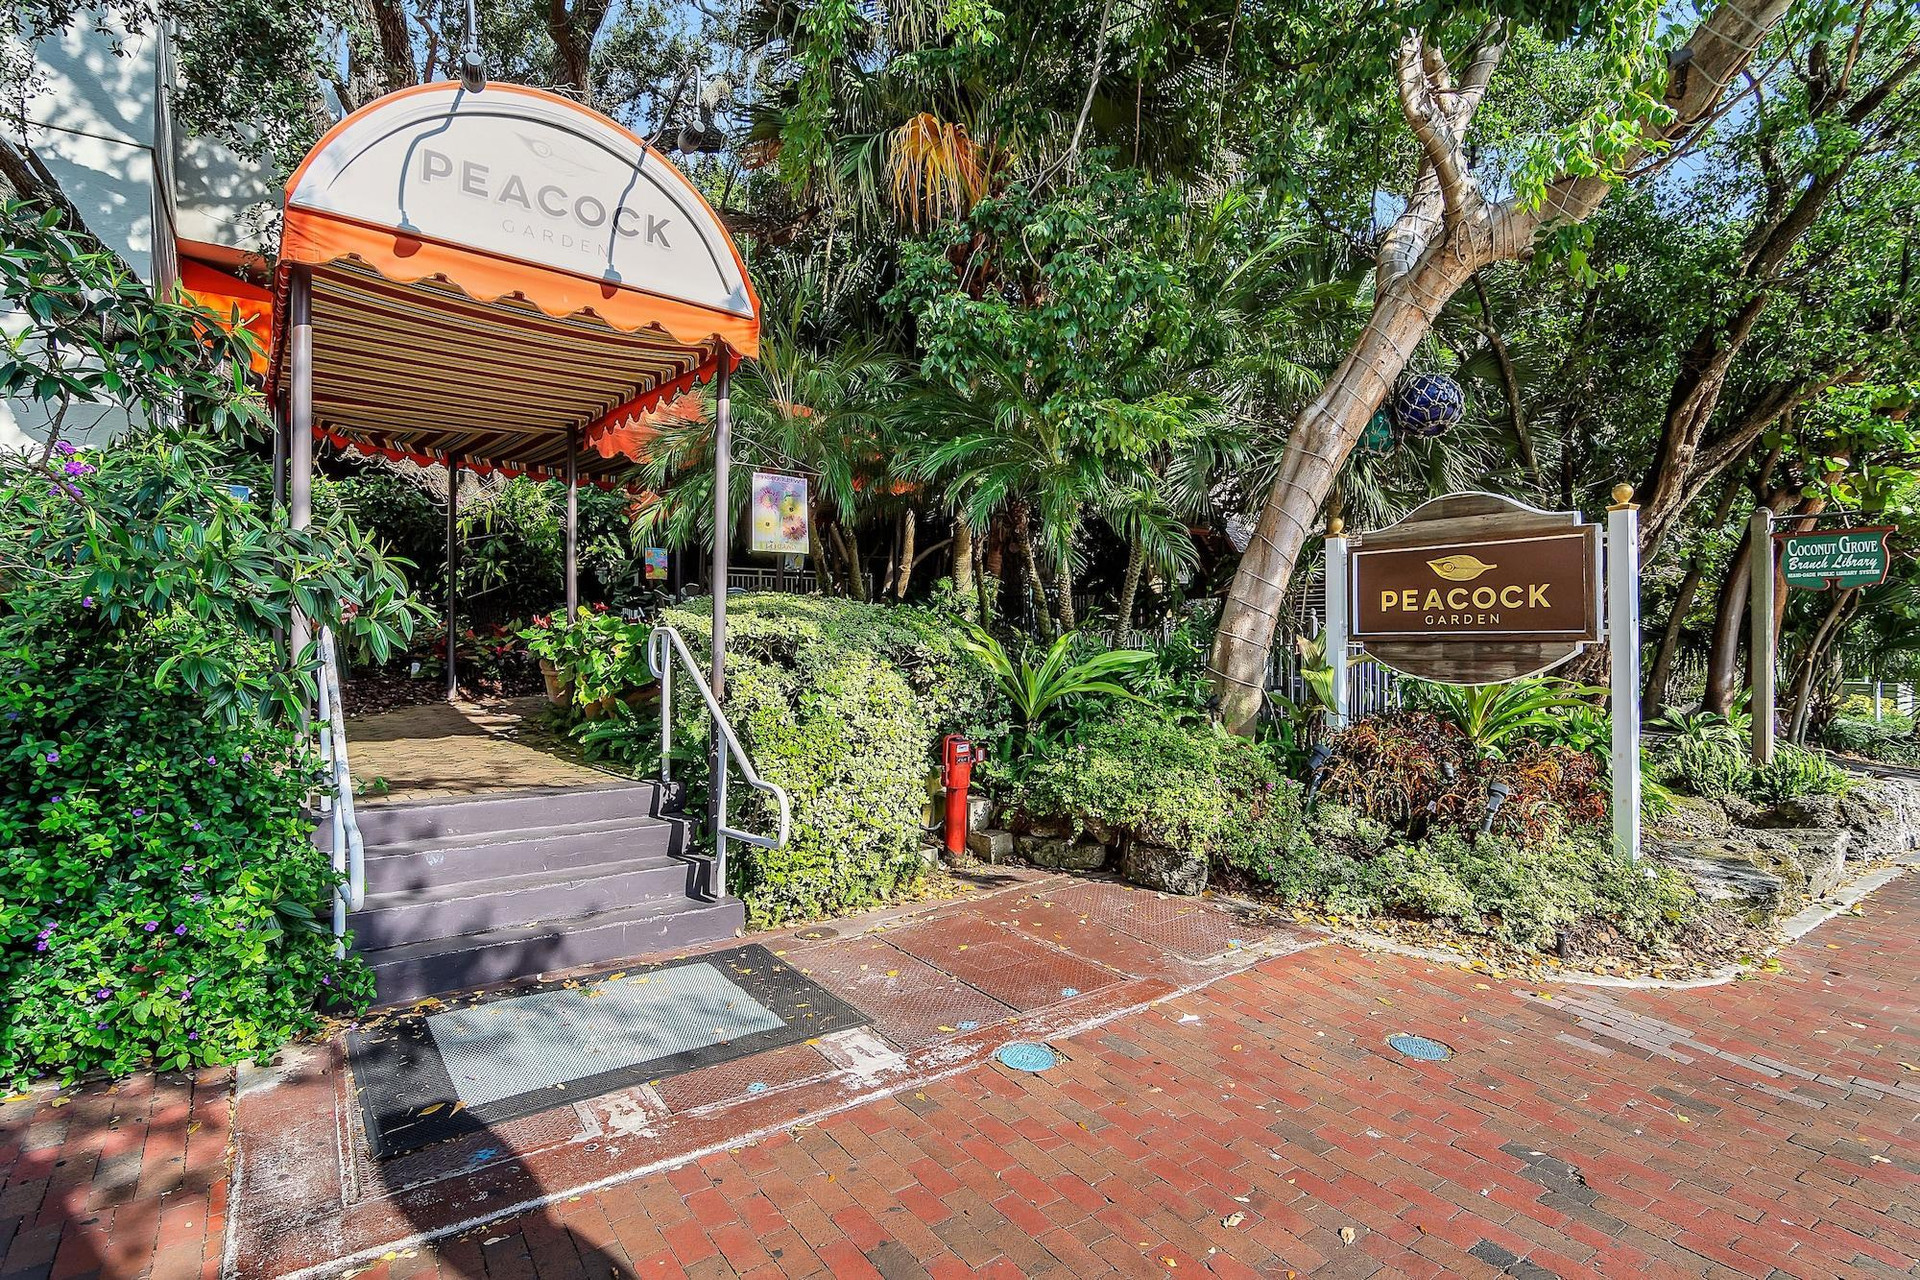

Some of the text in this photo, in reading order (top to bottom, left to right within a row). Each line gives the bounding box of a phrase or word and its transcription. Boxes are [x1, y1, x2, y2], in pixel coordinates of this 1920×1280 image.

[422, 148, 672, 249] PEACOCK
[501, 219, 610, 257] GARDEN
[1787, 536, 1878, 557] COCONUT GROVE
[1788, 554, 1878, 571] Branch Library
[1381, 583, 1551, 612] PEACOCK
[1424, 613, 1500, 625] GARDEN
